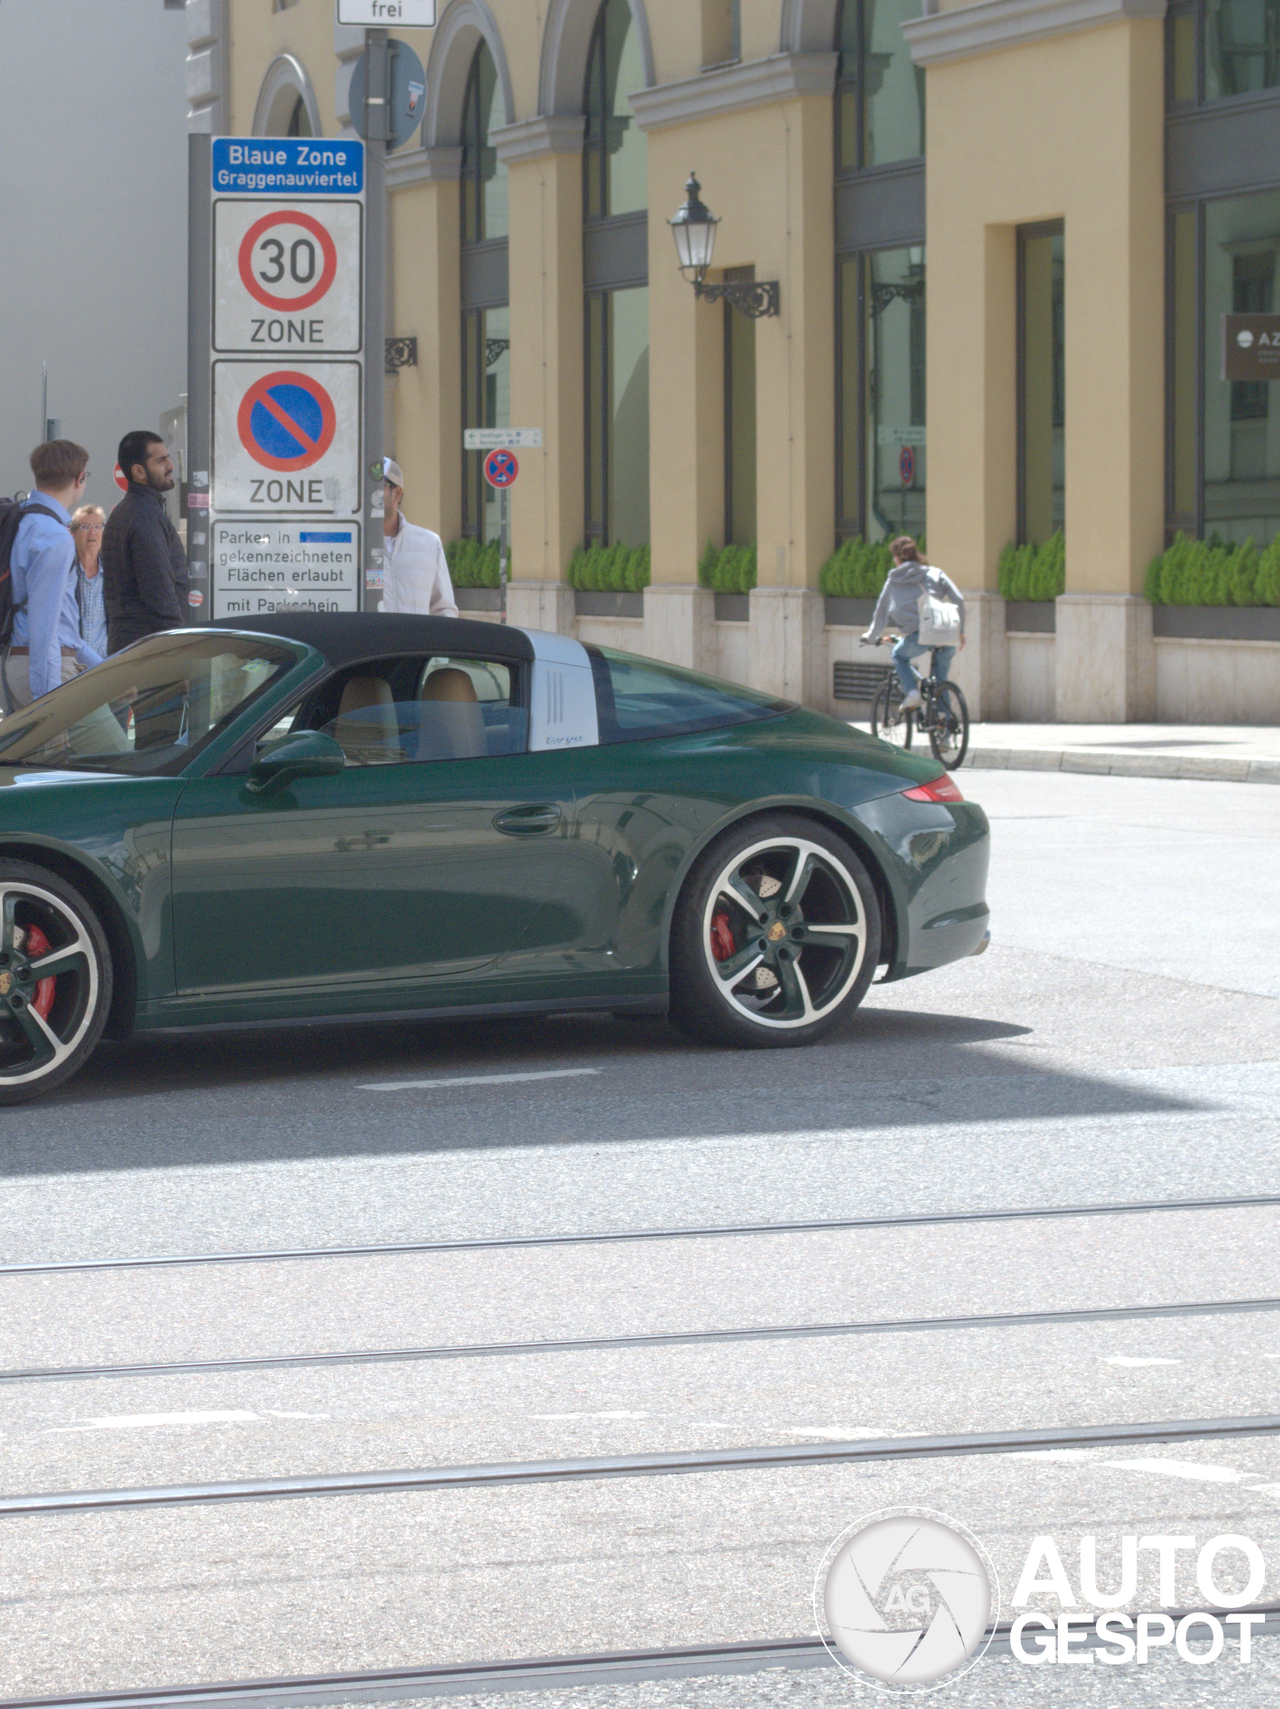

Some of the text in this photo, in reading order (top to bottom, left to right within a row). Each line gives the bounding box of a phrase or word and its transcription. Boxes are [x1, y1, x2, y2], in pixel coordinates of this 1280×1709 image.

[372, 0, 402, 17] frei
[229, 145, 347, 166] Blaue Zone
[218, 170, 357, 189] Graggenauviertel
[259, 238, 316, 284] 30
[250, 319, 324, 343] ZONE
[249, 480, 323, 503] ZONE
[220, 531, 290, 544] Parken in
[220, 549, 352, 566] gekennzeichneten
[228, 568, 344, 582] Flächen erlaubt
[227, 598, 251, 612] mit
